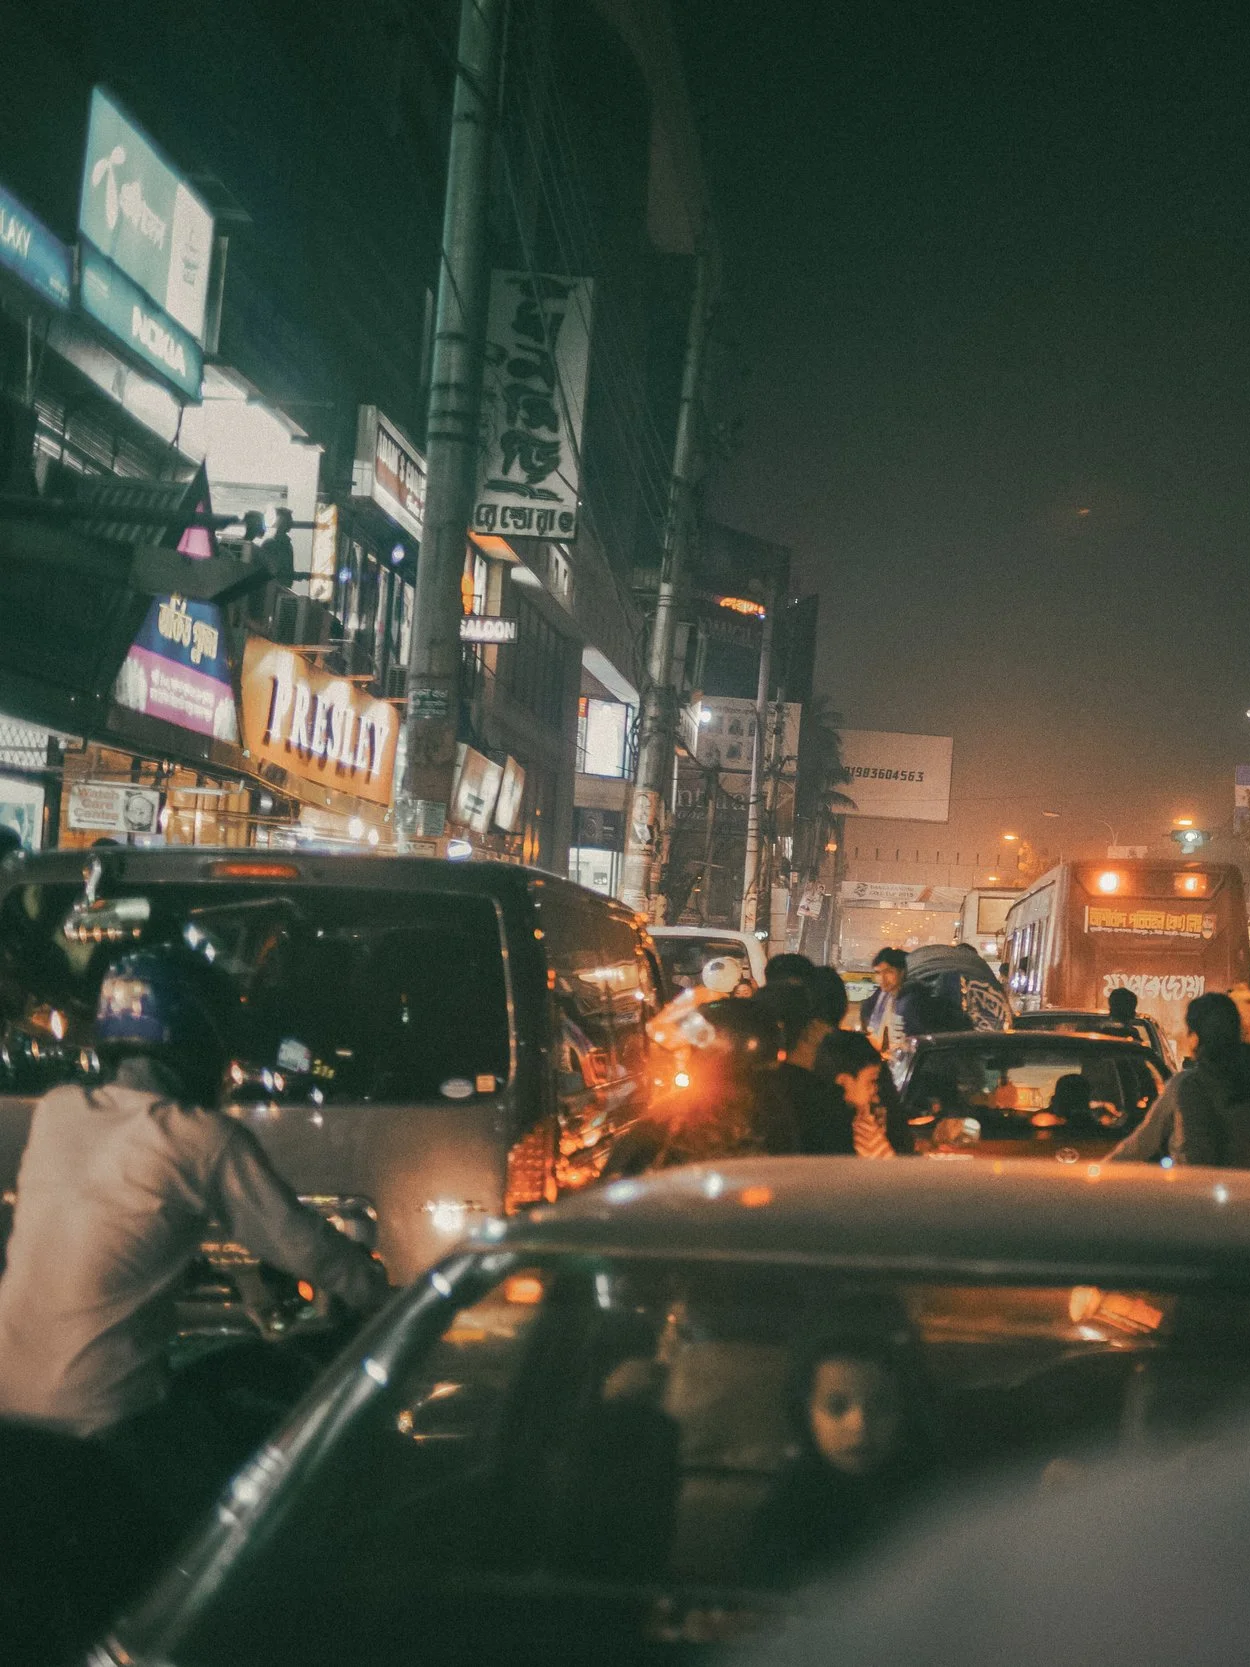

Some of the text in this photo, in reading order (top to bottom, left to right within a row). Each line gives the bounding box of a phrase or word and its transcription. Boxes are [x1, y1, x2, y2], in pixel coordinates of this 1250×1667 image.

[131, 305, 187, 377] NOKIA
[459, 618, 516, 641] SALOON
[268, 662, 390, 776] PRESLEY
[78, 786, 119, 800] Watch
[81, 799, 113, 810] Care
